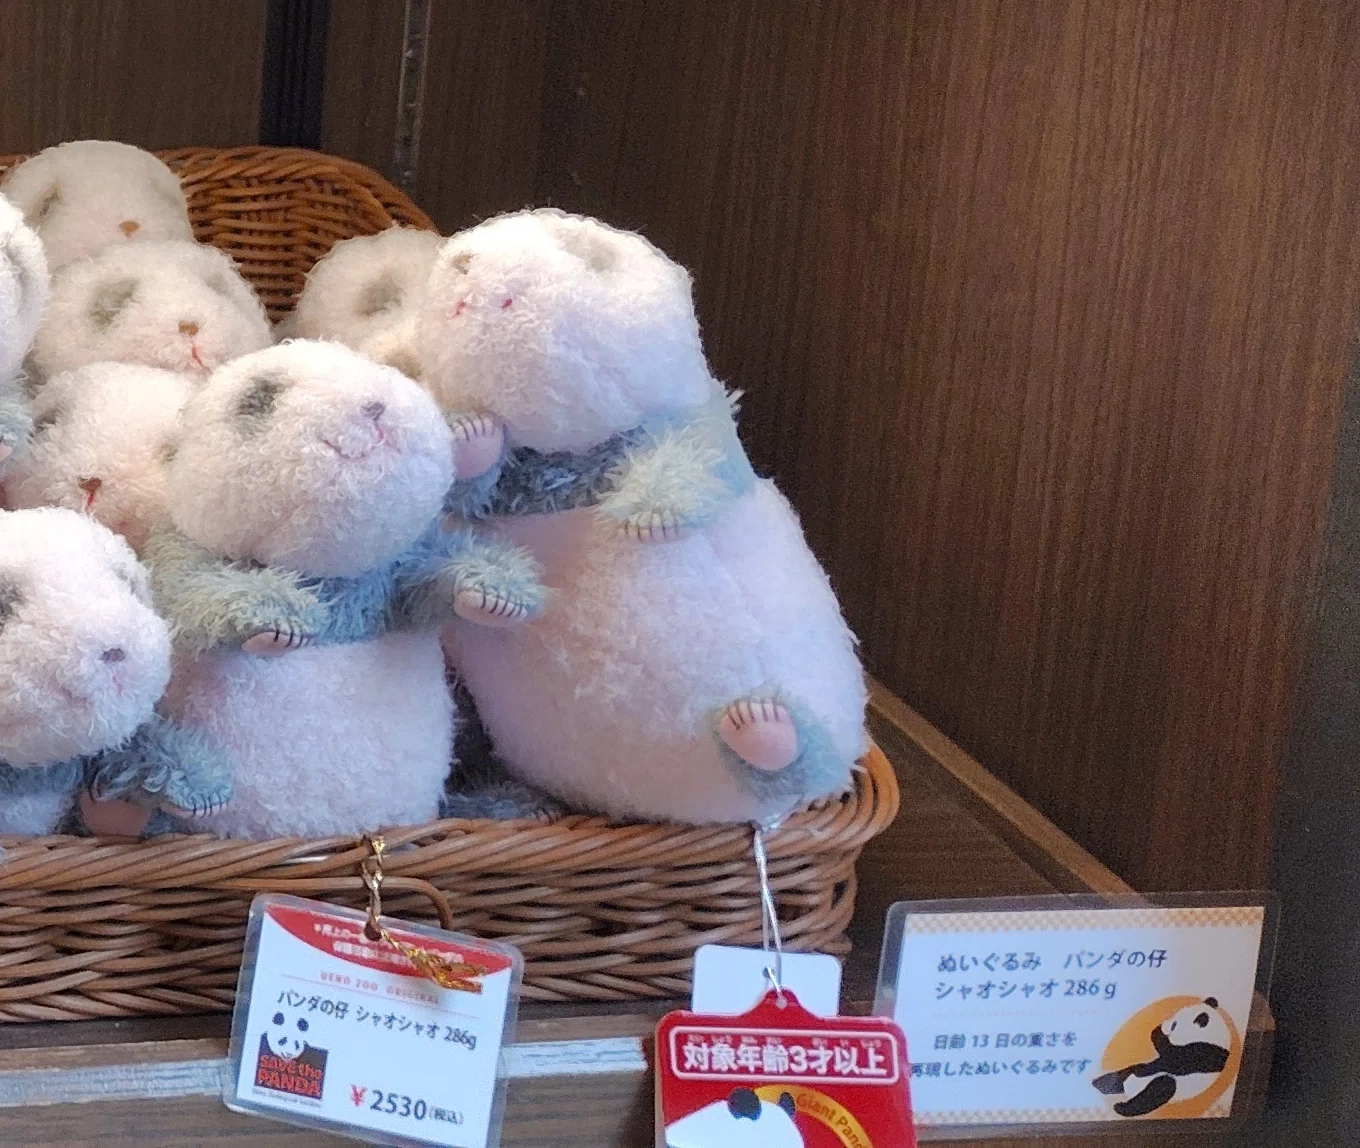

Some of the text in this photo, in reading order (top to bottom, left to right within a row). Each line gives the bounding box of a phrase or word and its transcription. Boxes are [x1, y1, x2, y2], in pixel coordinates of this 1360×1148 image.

[937, 948, 1168, 973] ぬいぐるみ パンダの仔
[935, 978, 1059, 1000] シャオシャオ
[277, 990, 478, 1051] パンダの仔 シャオシャオ 286g
[260, 1054, 297, 1074] SAVE
[683, 1042, 888, 1076] 対象年齢3才以上
[258, 1068, 321, 1096] PANDA
